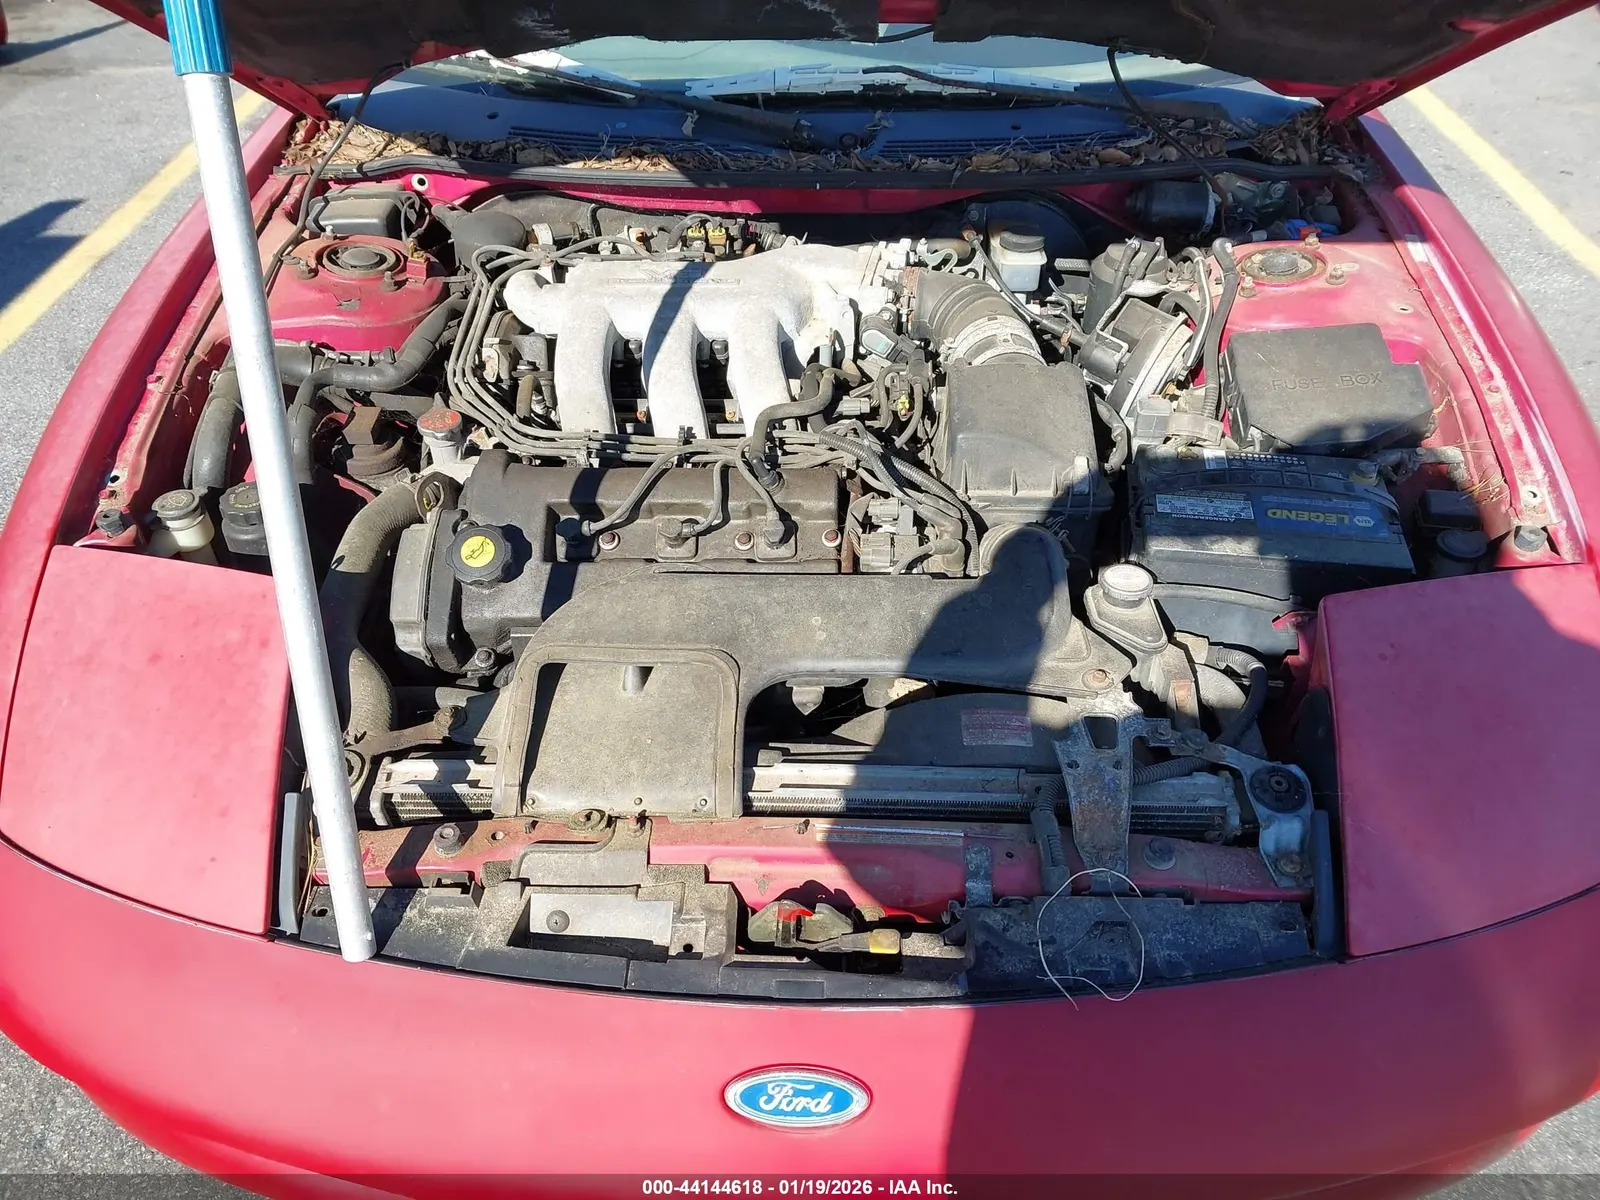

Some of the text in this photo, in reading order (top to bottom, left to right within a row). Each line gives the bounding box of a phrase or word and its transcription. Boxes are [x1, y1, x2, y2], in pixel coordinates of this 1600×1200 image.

[1272, 372, 1383, 391] FUSE BOX
[1266, 508, 1350, 526] LEGEND
[759, 1081, 834, 1114] Ford
